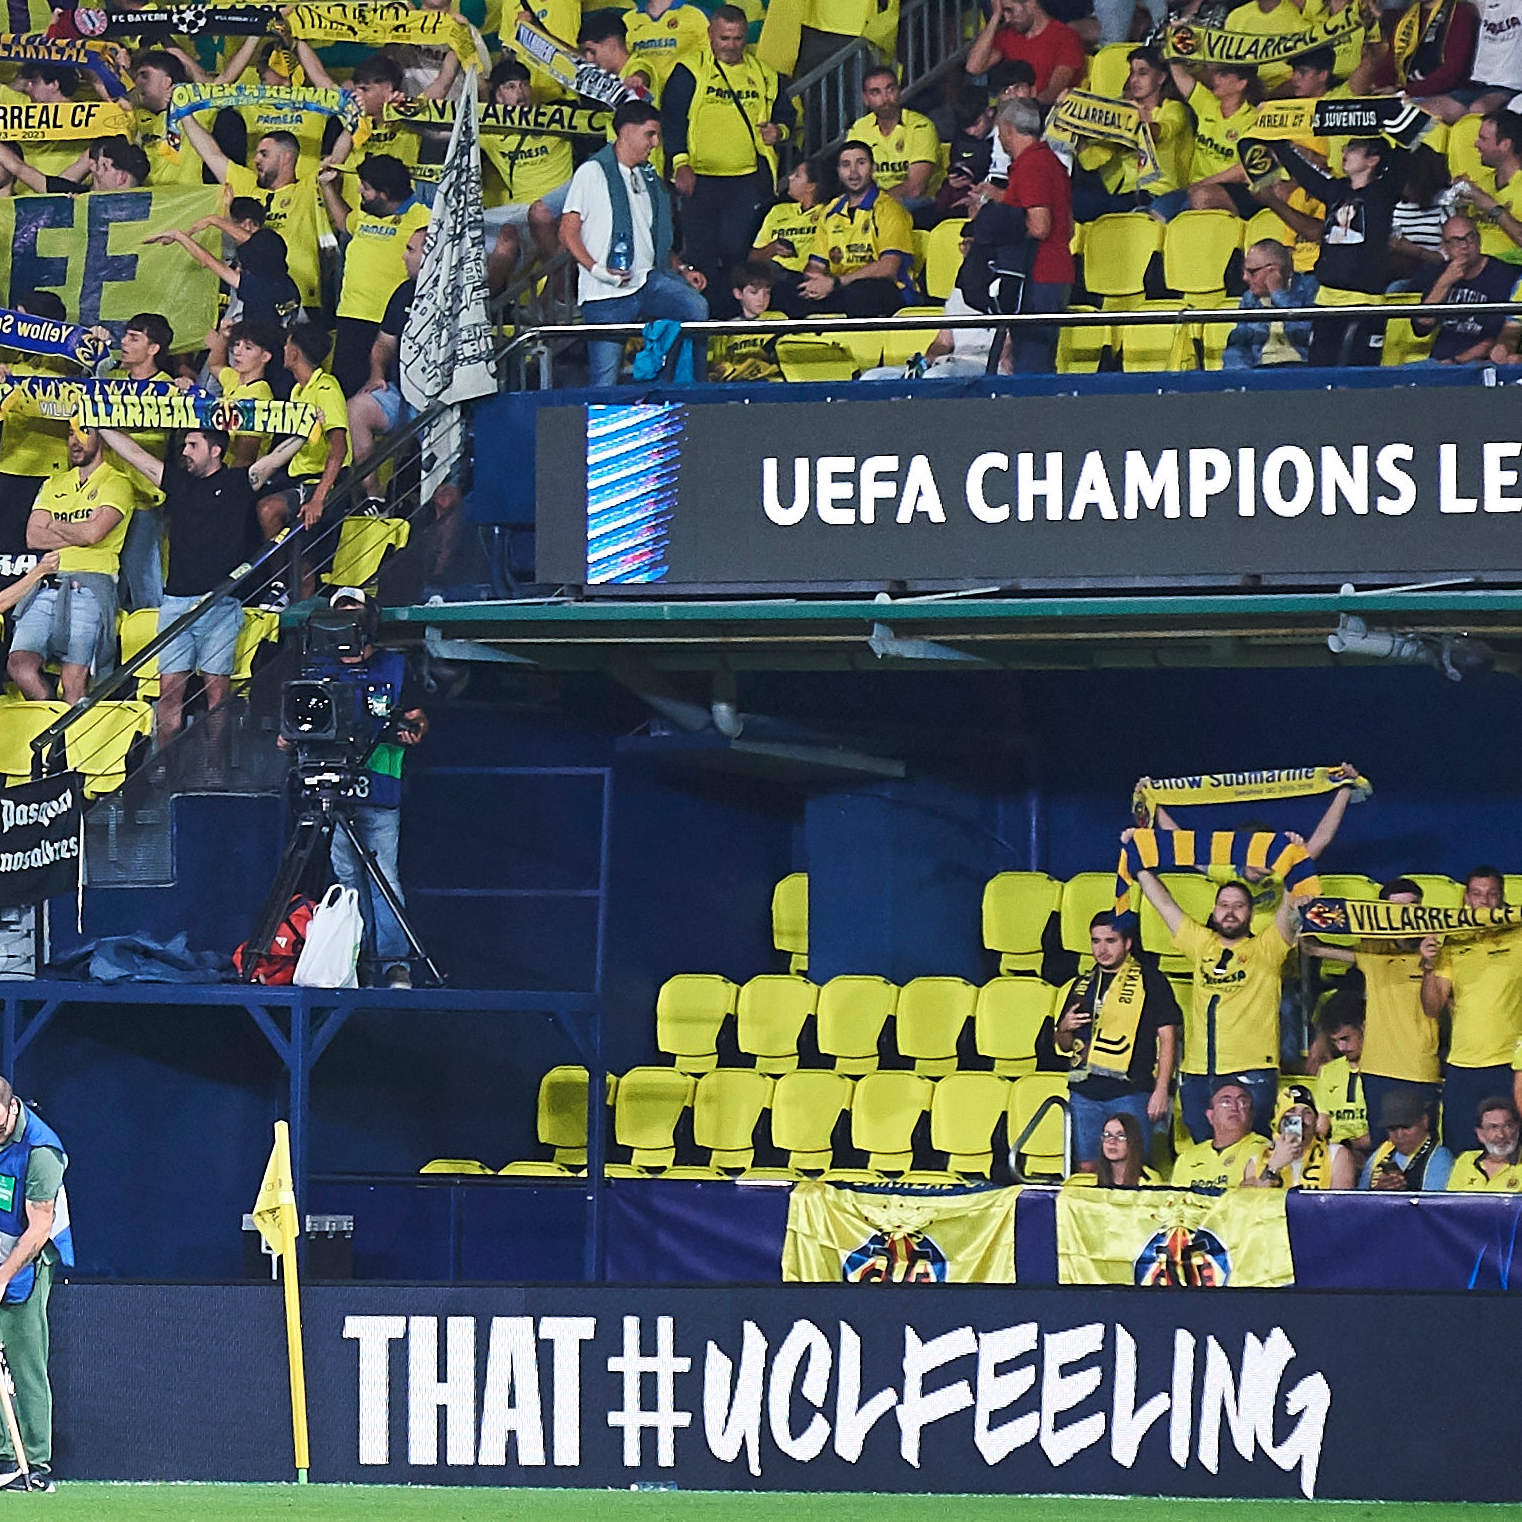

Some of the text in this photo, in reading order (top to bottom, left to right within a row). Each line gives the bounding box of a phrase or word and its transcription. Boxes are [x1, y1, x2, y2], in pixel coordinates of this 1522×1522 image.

[112, 10, 168, 24] FC BAYERN
[1207, 28, 1316, 62] VILLARREAL
[70, 104, 97, 129] CF
[1323, 111, 1377, 127] JUVENTUS
[760, 453, 947, 527] UEFA
[965, 442, 1418, 523] CHAMPIONS
[343, 1315, 1332, 1499] THAT #UCLFEELING
